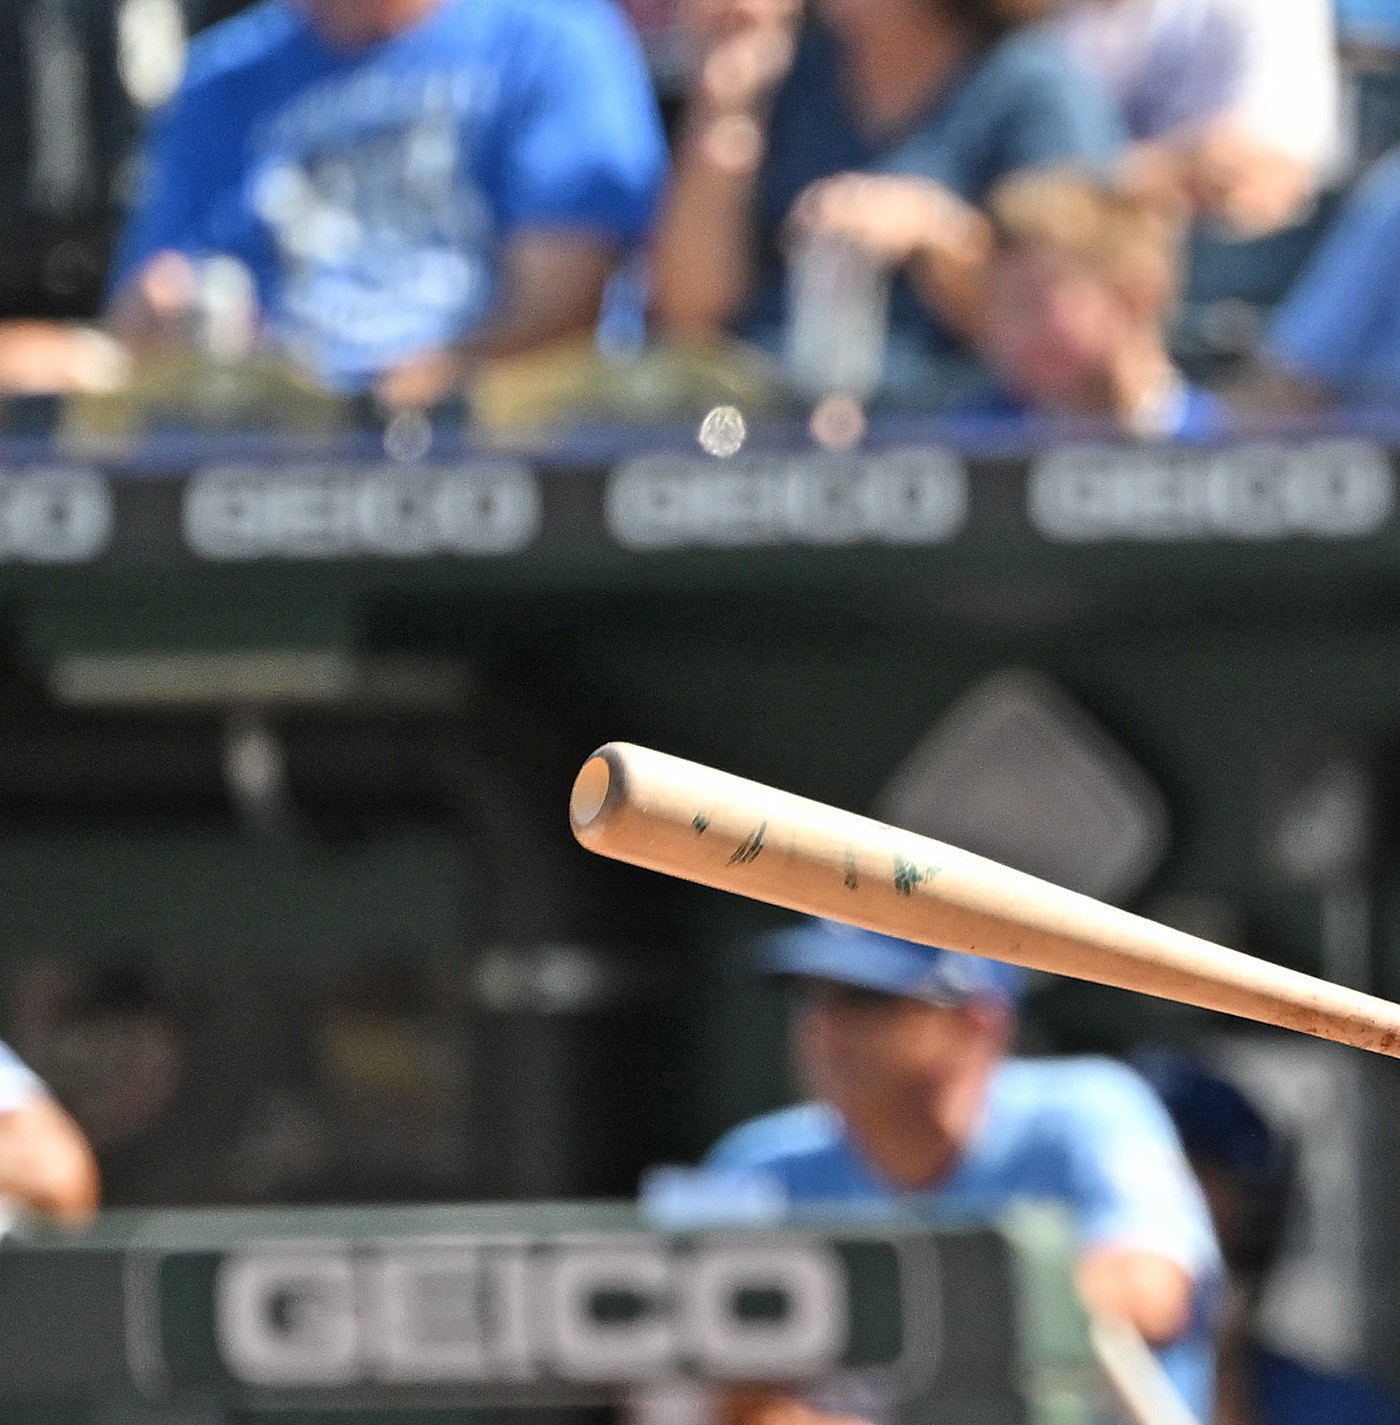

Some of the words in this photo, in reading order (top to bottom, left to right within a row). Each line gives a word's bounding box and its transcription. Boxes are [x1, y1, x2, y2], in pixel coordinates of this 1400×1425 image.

[183, 464, 538, 558] GEICO
[607, 454, 967, 547] GEICO
[1028, 442, 1393, 541] GEICO
[215, 1237, 847, 1384] GEICO
